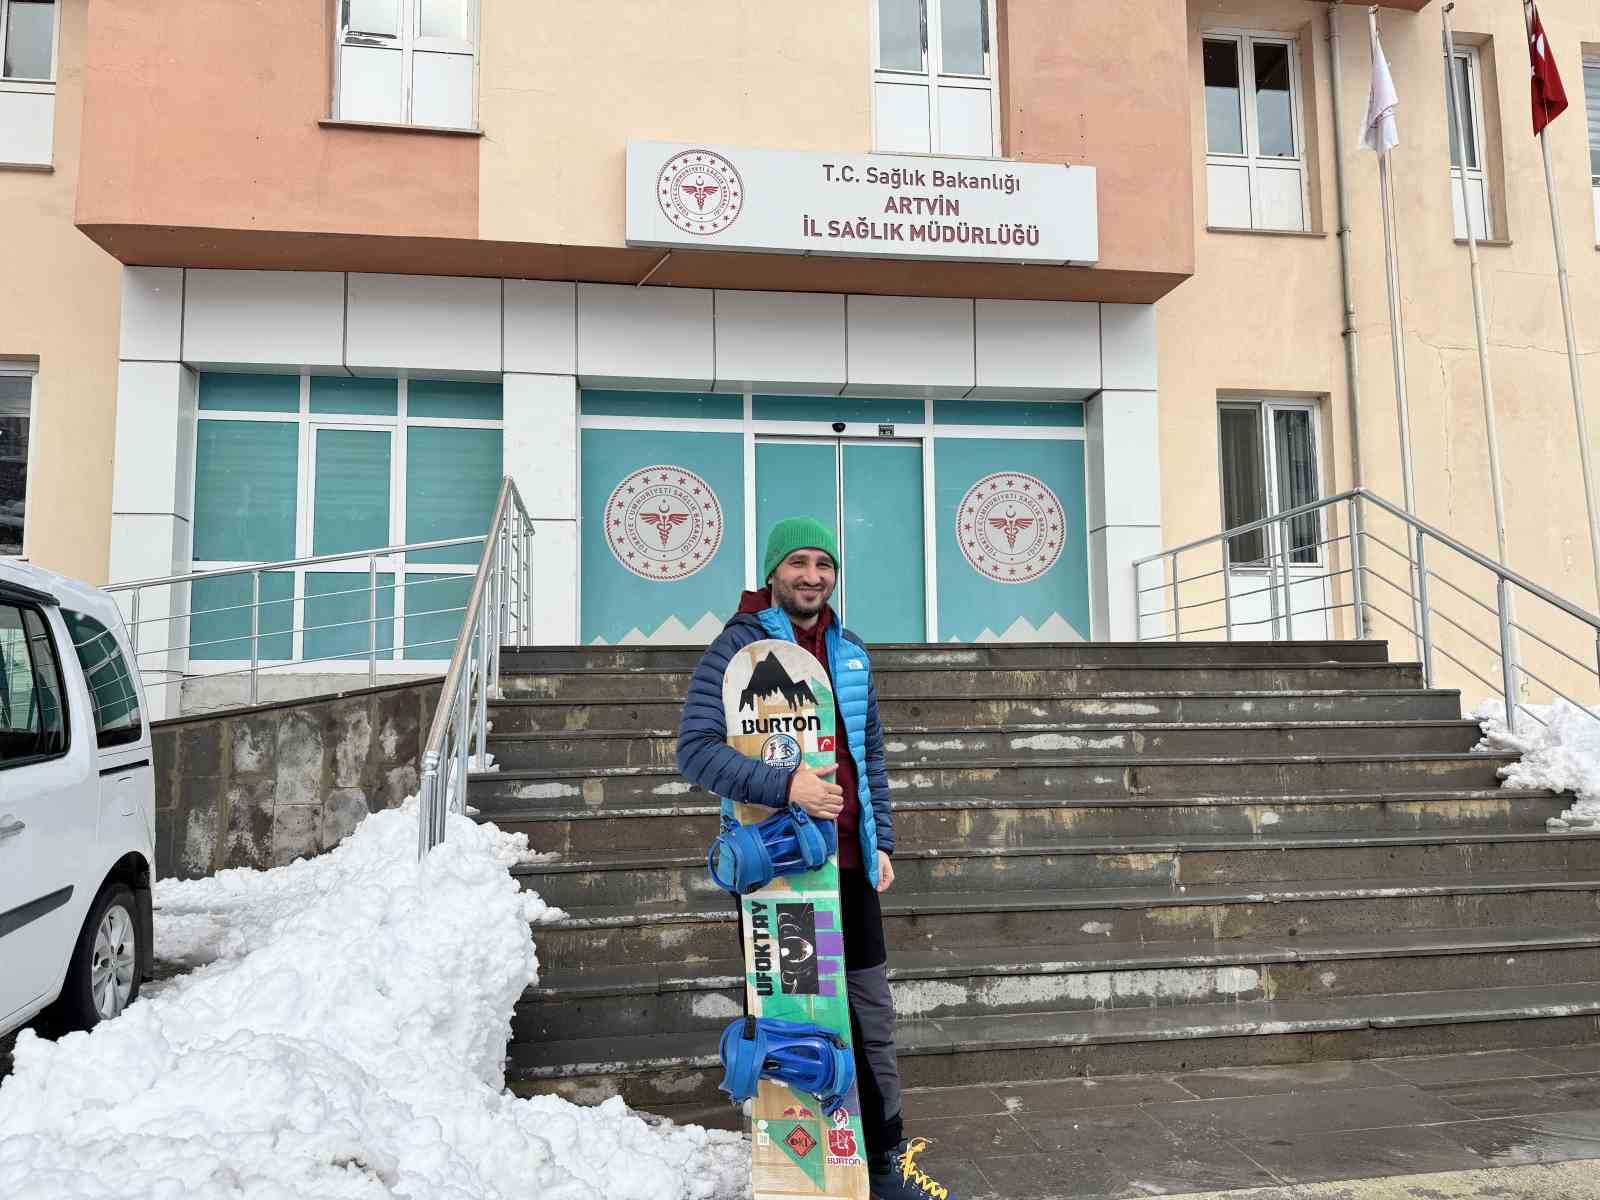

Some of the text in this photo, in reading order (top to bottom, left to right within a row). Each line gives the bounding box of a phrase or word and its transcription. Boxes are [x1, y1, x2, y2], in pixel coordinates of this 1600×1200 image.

[822, 164, 1020, 194] T.C. Sağlık Bakanlığı
[884, 194, 960, 216] ARTVİN
[803, 214, 1040, 246] İL SAĞLIK MÜDÜRLÜĞÜ
[741, 715, 821, 735] BURTON
[827, 1157, 861, 1166] BURTON
